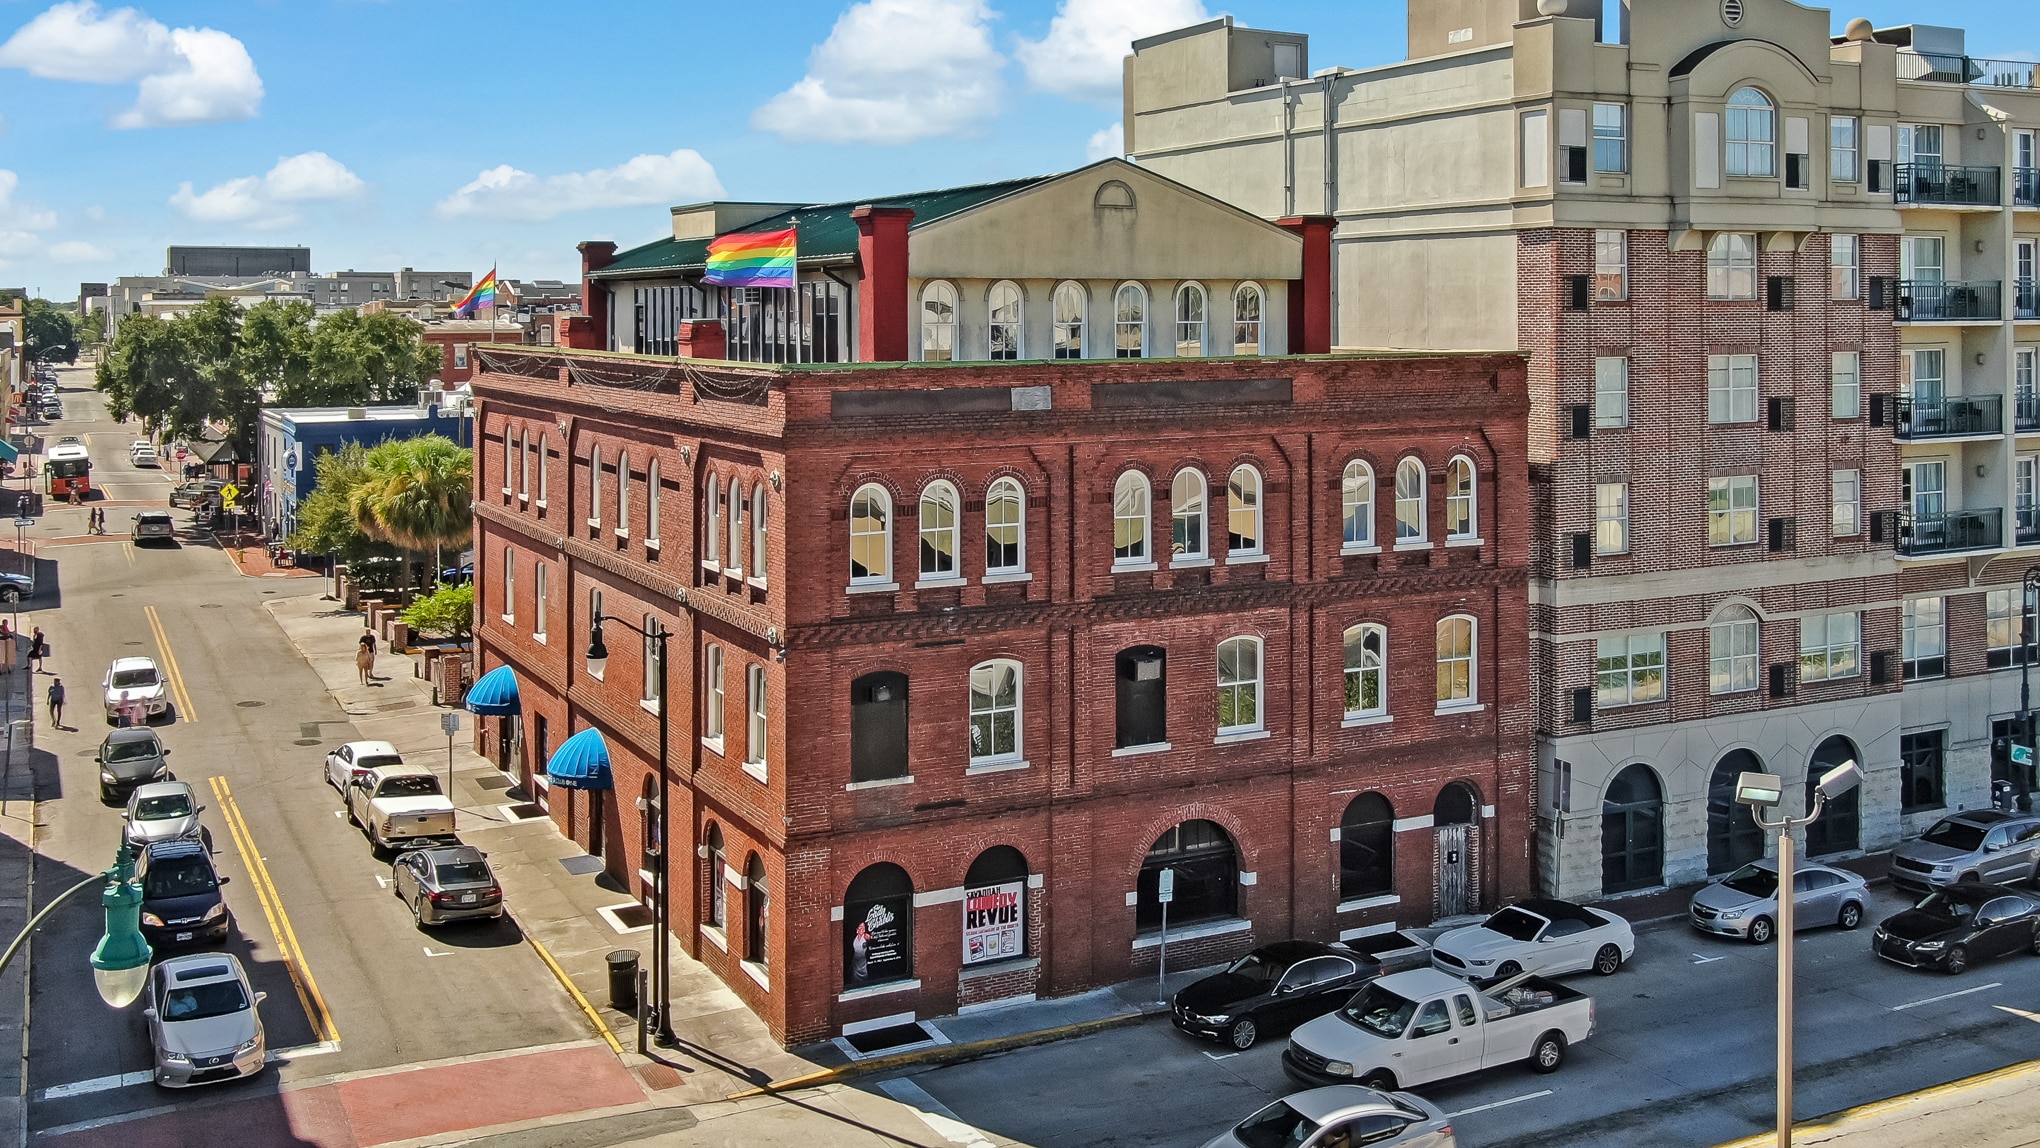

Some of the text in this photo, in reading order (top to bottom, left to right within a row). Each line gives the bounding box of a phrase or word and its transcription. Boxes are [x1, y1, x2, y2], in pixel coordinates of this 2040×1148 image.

[967, 886, 1000, 899] SAVANNAH
[967, 891, 1017, 912] COMEDY
[966, 902, 1018, 930] REVUE
